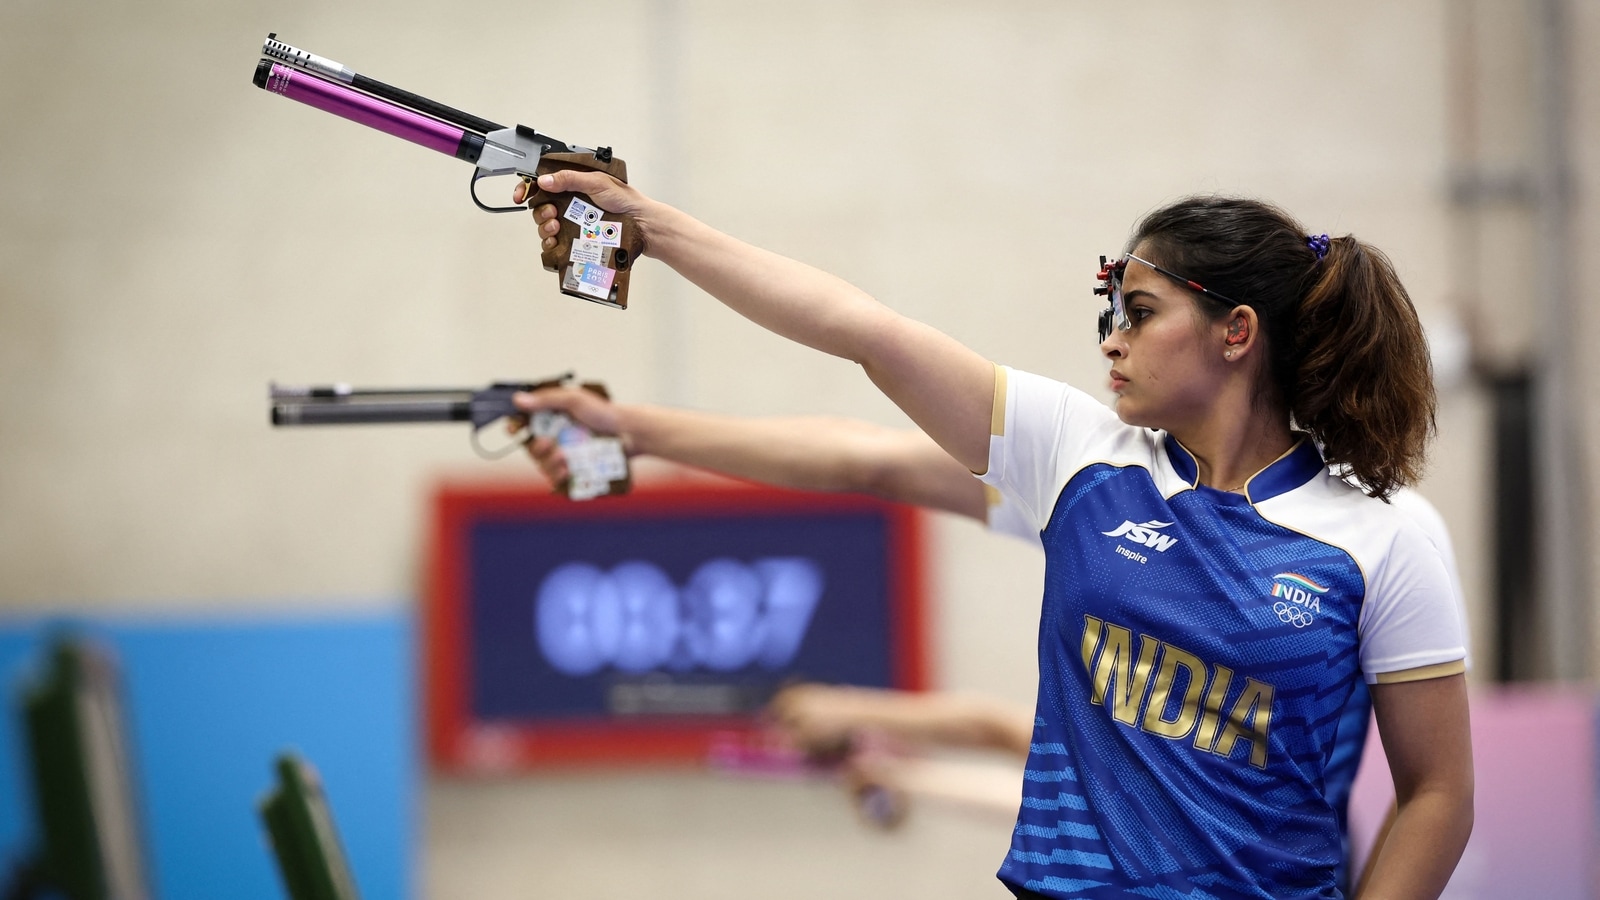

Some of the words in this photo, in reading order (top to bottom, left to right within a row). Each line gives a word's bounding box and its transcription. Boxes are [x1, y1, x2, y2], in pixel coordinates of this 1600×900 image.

[586, 273, 608, 284] 2024
[588, 267, 609, 279] PARIS
[1101, 519, 1178, 552] JSW
[1115, 544, 1148, 565] Inspire
[1271, 583, 1321, 614] INDIA
[1081, 614, 1276, 771] INDIA
